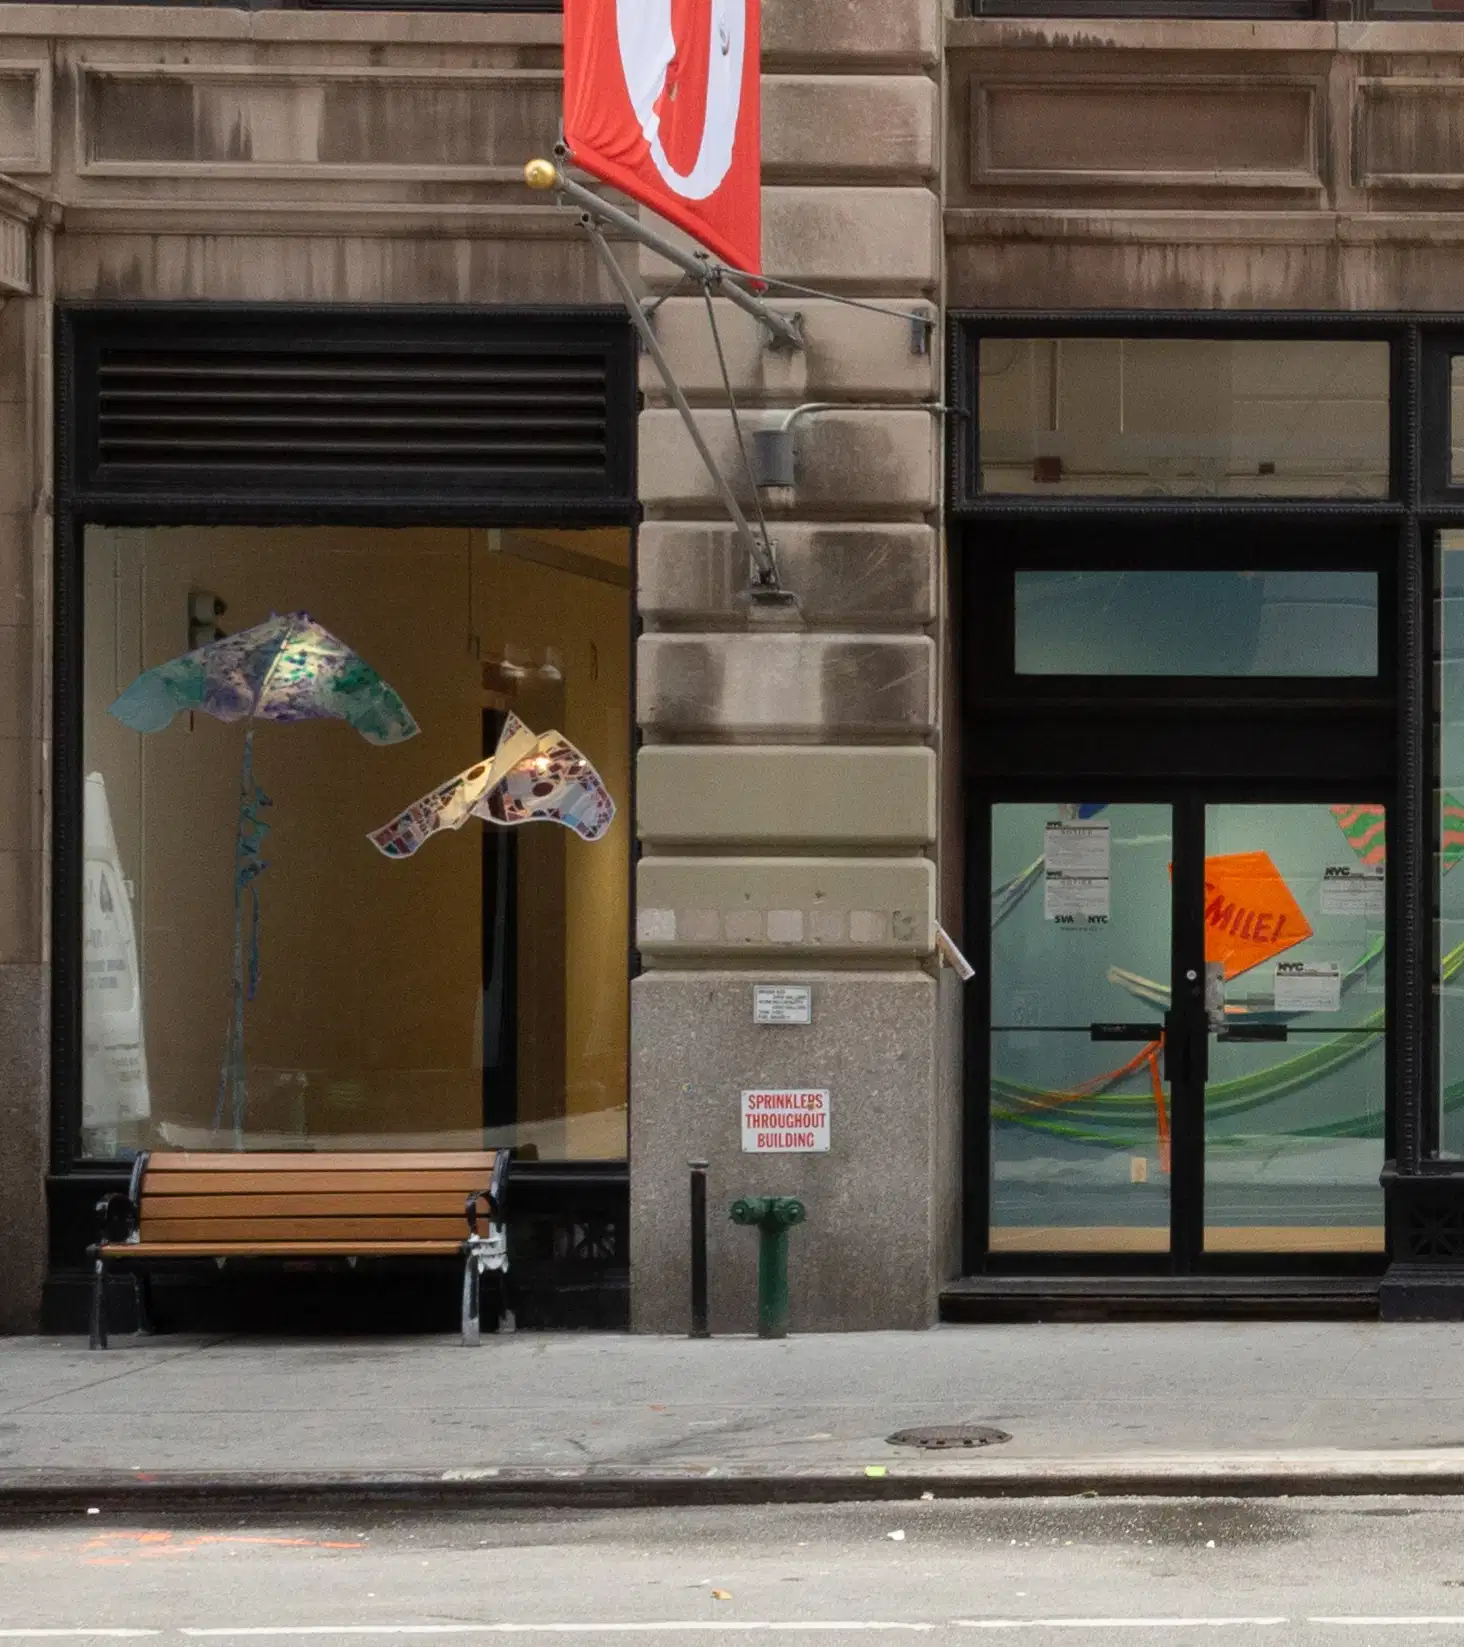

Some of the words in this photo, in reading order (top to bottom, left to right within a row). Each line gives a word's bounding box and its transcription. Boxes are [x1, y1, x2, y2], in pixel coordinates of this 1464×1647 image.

[1325, 867, 1350, 876] NYC
[1055, 915, 1074, 924] SVA
[1088, 915, 1108, 924] NYC
[1205, 884, 1286, 944] MILE!
[1278, 962, 1304, 972] NYC
[748, 1094, 823, 1110] SPRINKLERS
[745, 1113, 825, 1128] THROUGHOUT
[757, 1132, 814, 1148] BUILDING
